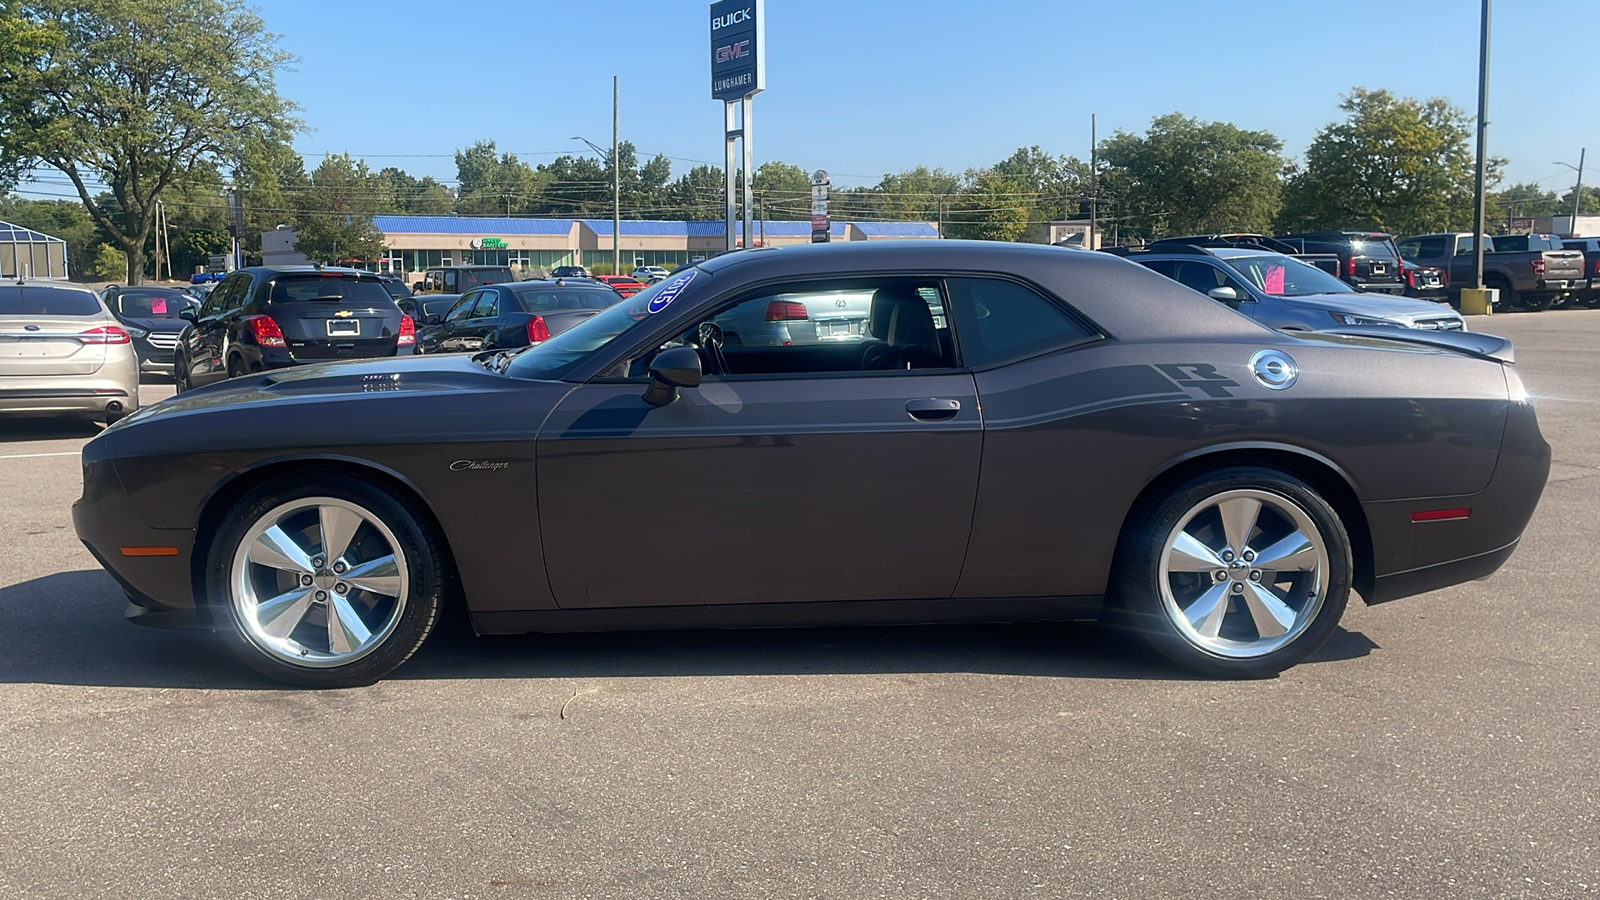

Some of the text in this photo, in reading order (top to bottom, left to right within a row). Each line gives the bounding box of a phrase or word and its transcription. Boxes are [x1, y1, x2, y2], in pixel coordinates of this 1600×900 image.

[712, 7, 752, 31] BUICK
[715, 39, 750, 63] GMC
[714, 72, 752, 91] LUNGHAMER
[653, 276, 691, 304] 2015
[449, 459, 509, 472] Challenger
